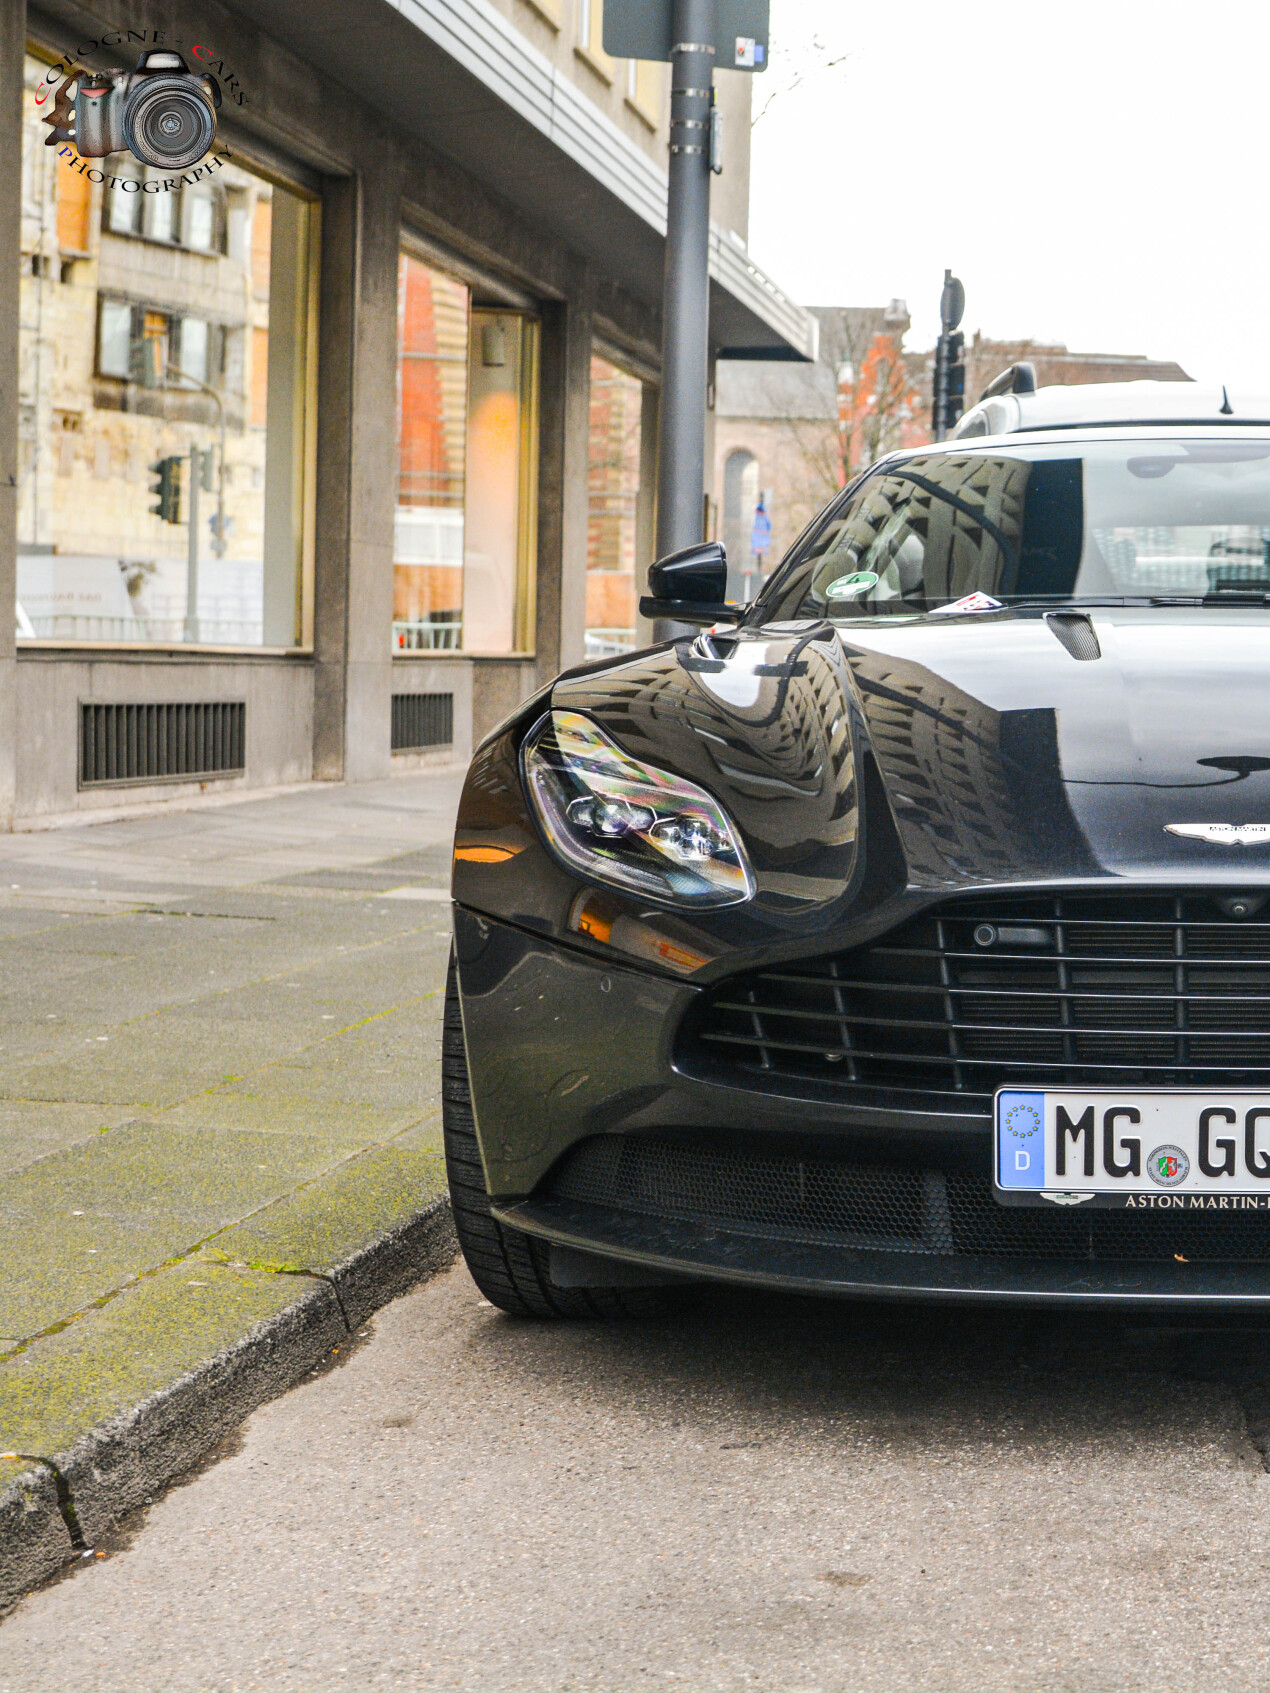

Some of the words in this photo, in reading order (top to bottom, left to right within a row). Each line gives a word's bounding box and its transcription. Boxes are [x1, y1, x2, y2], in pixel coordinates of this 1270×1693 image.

[1056, 1105, 1141, 1178] MG
[1015, 1150, 1031, 1171] D
[1125, 1194, 1184, 1208] ASTON
